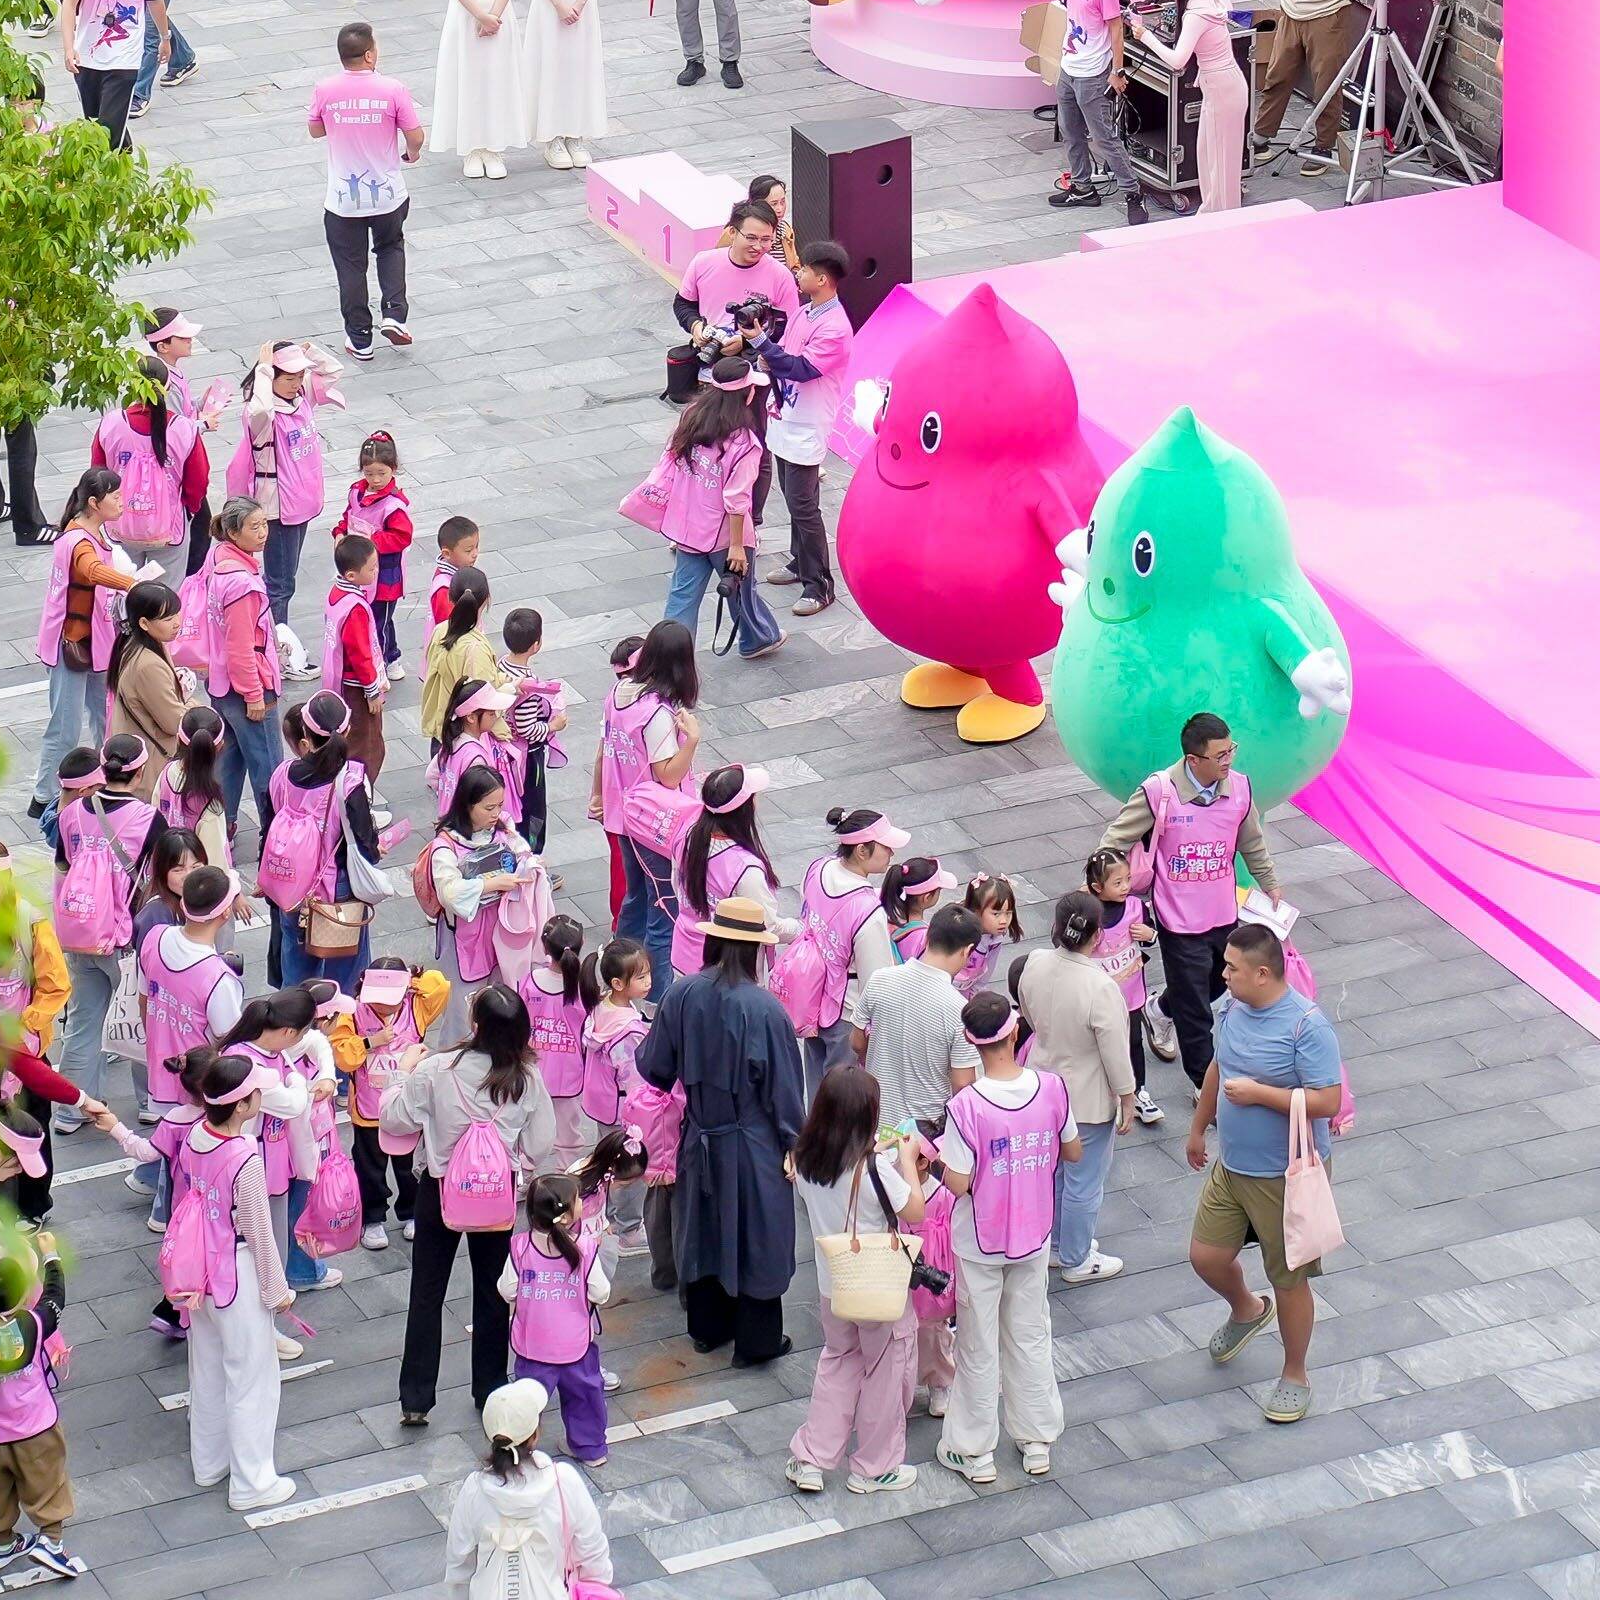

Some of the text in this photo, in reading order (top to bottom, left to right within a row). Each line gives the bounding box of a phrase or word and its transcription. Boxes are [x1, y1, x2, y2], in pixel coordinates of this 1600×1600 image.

[606, 195, 620, 231] 2
[662, 224, 672, 265] 1
[1179, 841, 1227, 859] 护城长
[990, 1130, 1055, 1159] 伊起奔赴
[991, 1153, 1051, 1178] 爱的守护
[521, 1268, 581, 1288] 伊起奔赴
[520, 1284, 578, 1303] 爱的守护
